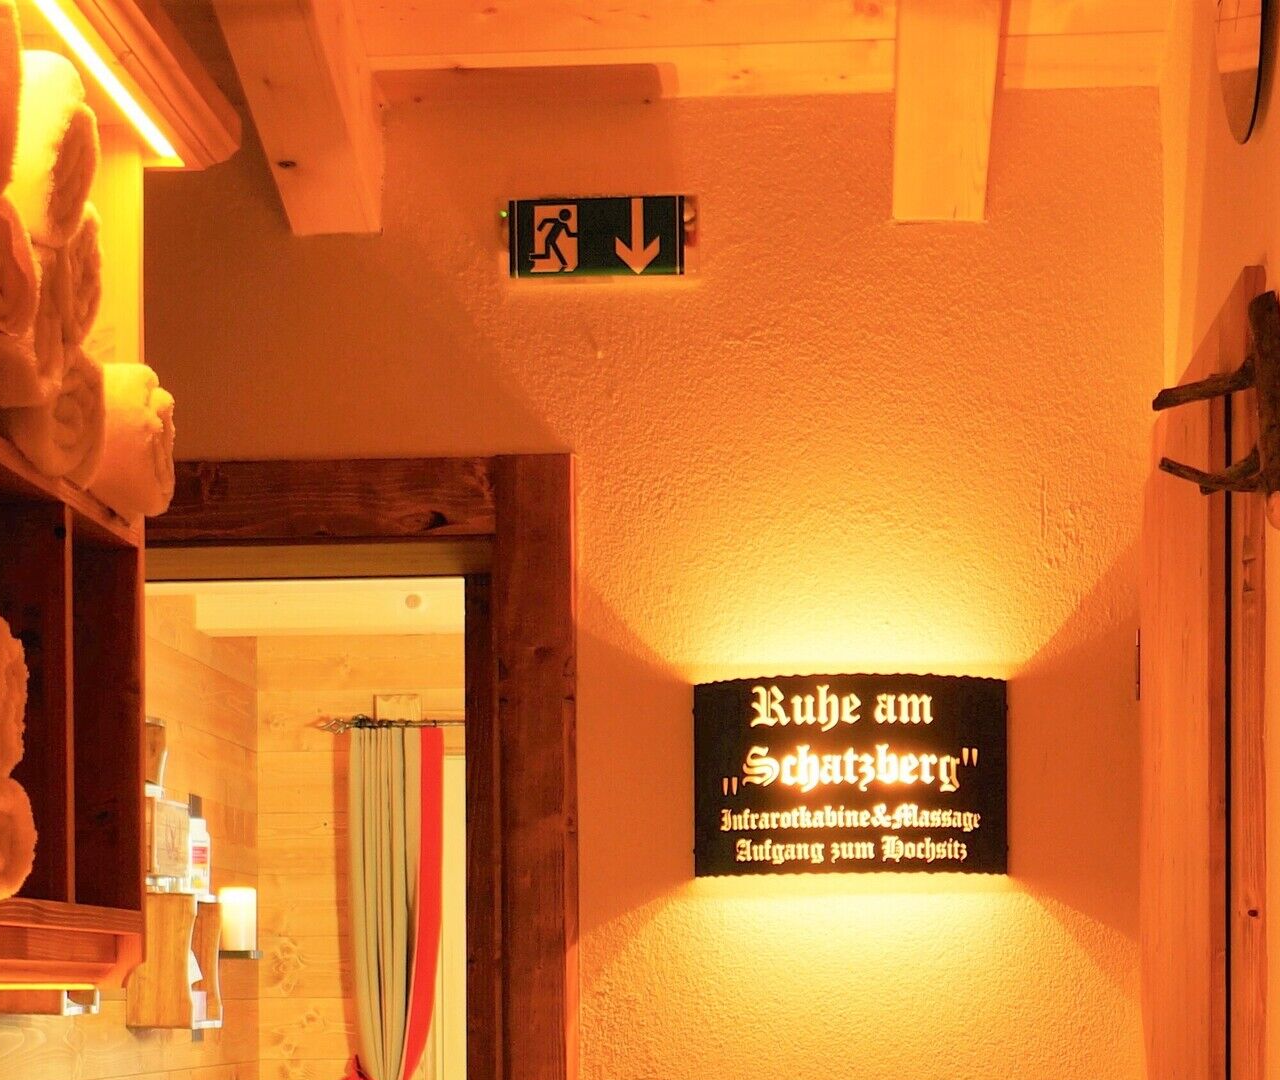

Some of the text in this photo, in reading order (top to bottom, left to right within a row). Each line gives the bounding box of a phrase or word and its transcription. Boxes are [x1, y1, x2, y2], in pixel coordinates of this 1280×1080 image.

[750, 684, 934, 732] Ruhe am
[736, 835, 968, 865] Aufgang zum Hochsitz
